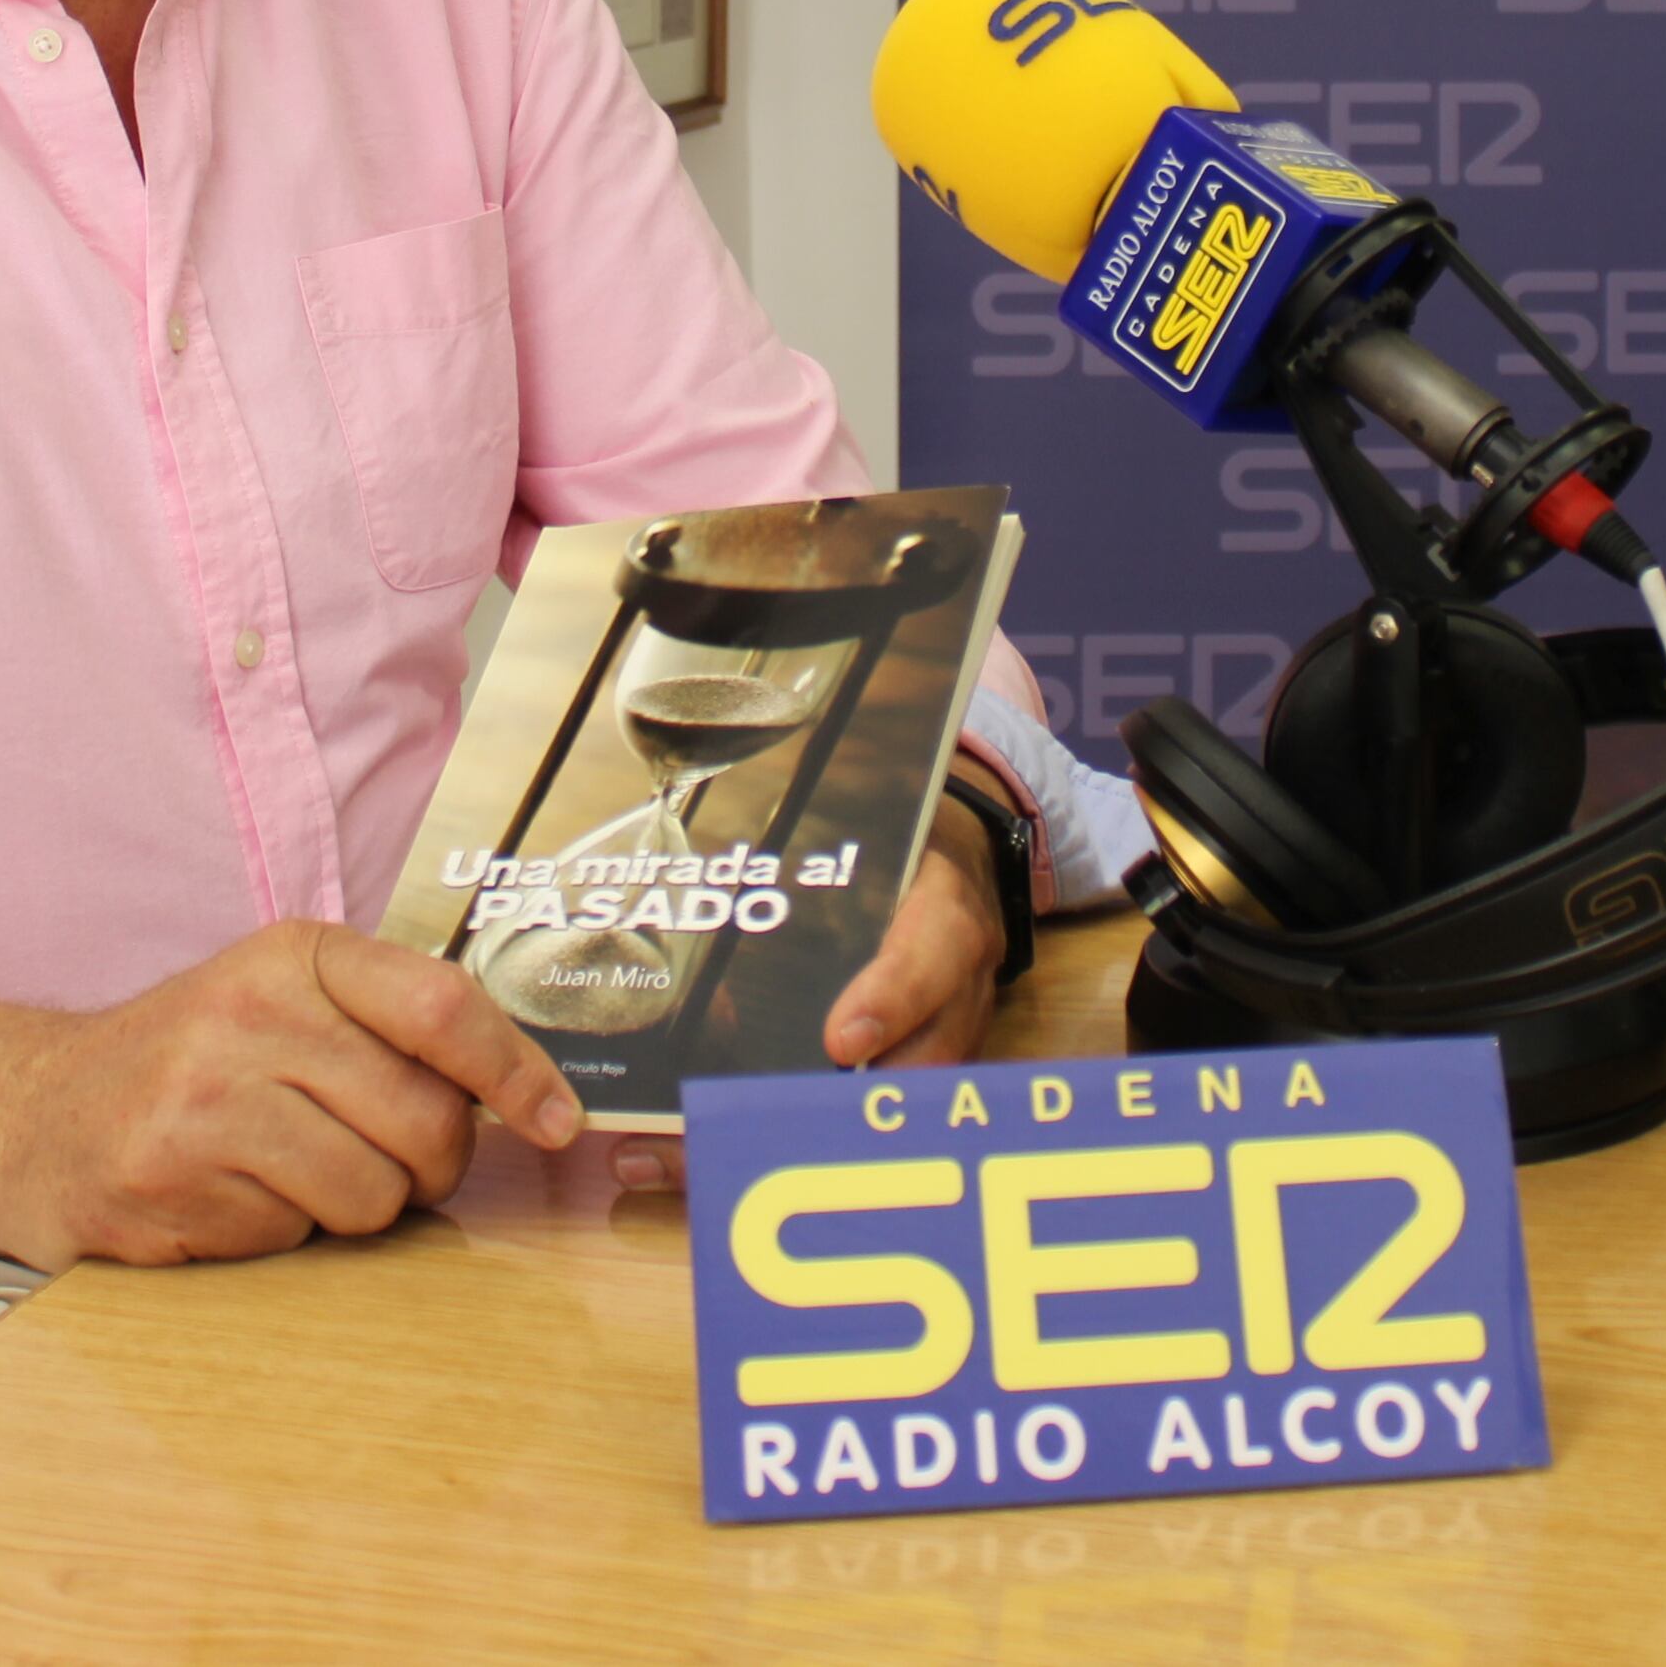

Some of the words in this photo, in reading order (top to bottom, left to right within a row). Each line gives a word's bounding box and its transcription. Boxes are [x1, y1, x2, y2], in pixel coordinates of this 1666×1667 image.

[1088, 233, 1141, 311] RADIO
[1132, 148, 1185, 236] ALCOY
[1128, 182, 1223, 337] CADENA
[1152, 203, 1272, 376] SER
[441, 850, 558, 888] Una
[571, 844, 781, 886] mirada
[797, 843, 859, 887] al
[468, 889, 789, 934] PASADO
[540, 965, 602, 988] Juan
[611, 966, 671, 991] Miró
[863, 1060, 1325, 1132] CADENA
[729, 1130, 1487, 1407] SER
[742, 1404, 1087, 1498] RADIO
[1148, 1378, 1492, 1473] ALCOY
